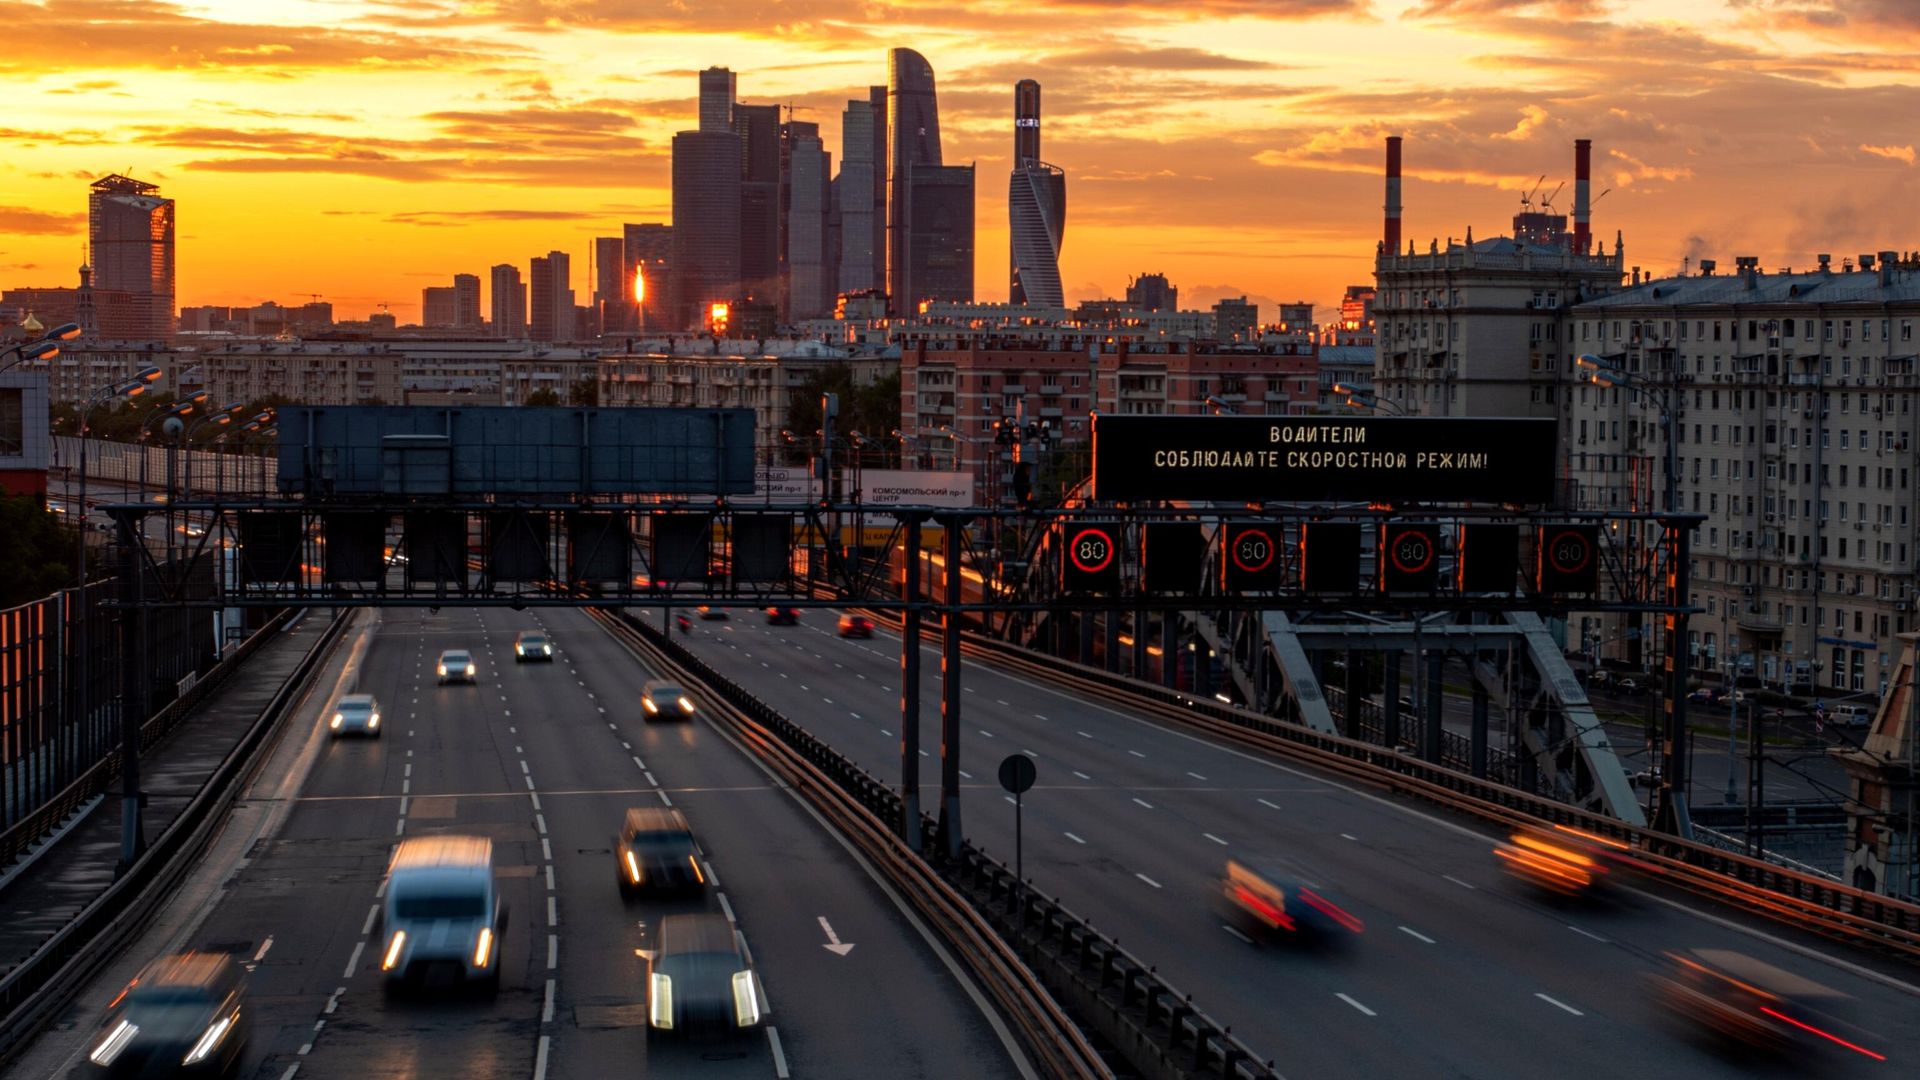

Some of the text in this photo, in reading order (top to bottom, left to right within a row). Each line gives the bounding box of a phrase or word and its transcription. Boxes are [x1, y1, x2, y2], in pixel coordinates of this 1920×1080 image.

[1270, 426, 1366, 443] ВОДИТЕЛИ
[1154, 451, 1488, 469] СОБЛЮДАЙТЕ СКОРОСТНОЙ РЕЖИМ!
[755, 472, 785, 480] ОЛЬЦО
[755, 483, 783, 491] ВСКИЙ
[872, 487, 947, 496] КОМСОМОЛЬСКИЙ
[872, 495, 900, 503] ЦЕНТР
[1080, 541, 1105, 560] 80
[1241, 541, 1266, 560] 80
[1400, 543, 1425, 561] 80
[1558, 543, 1582, 561] 80
